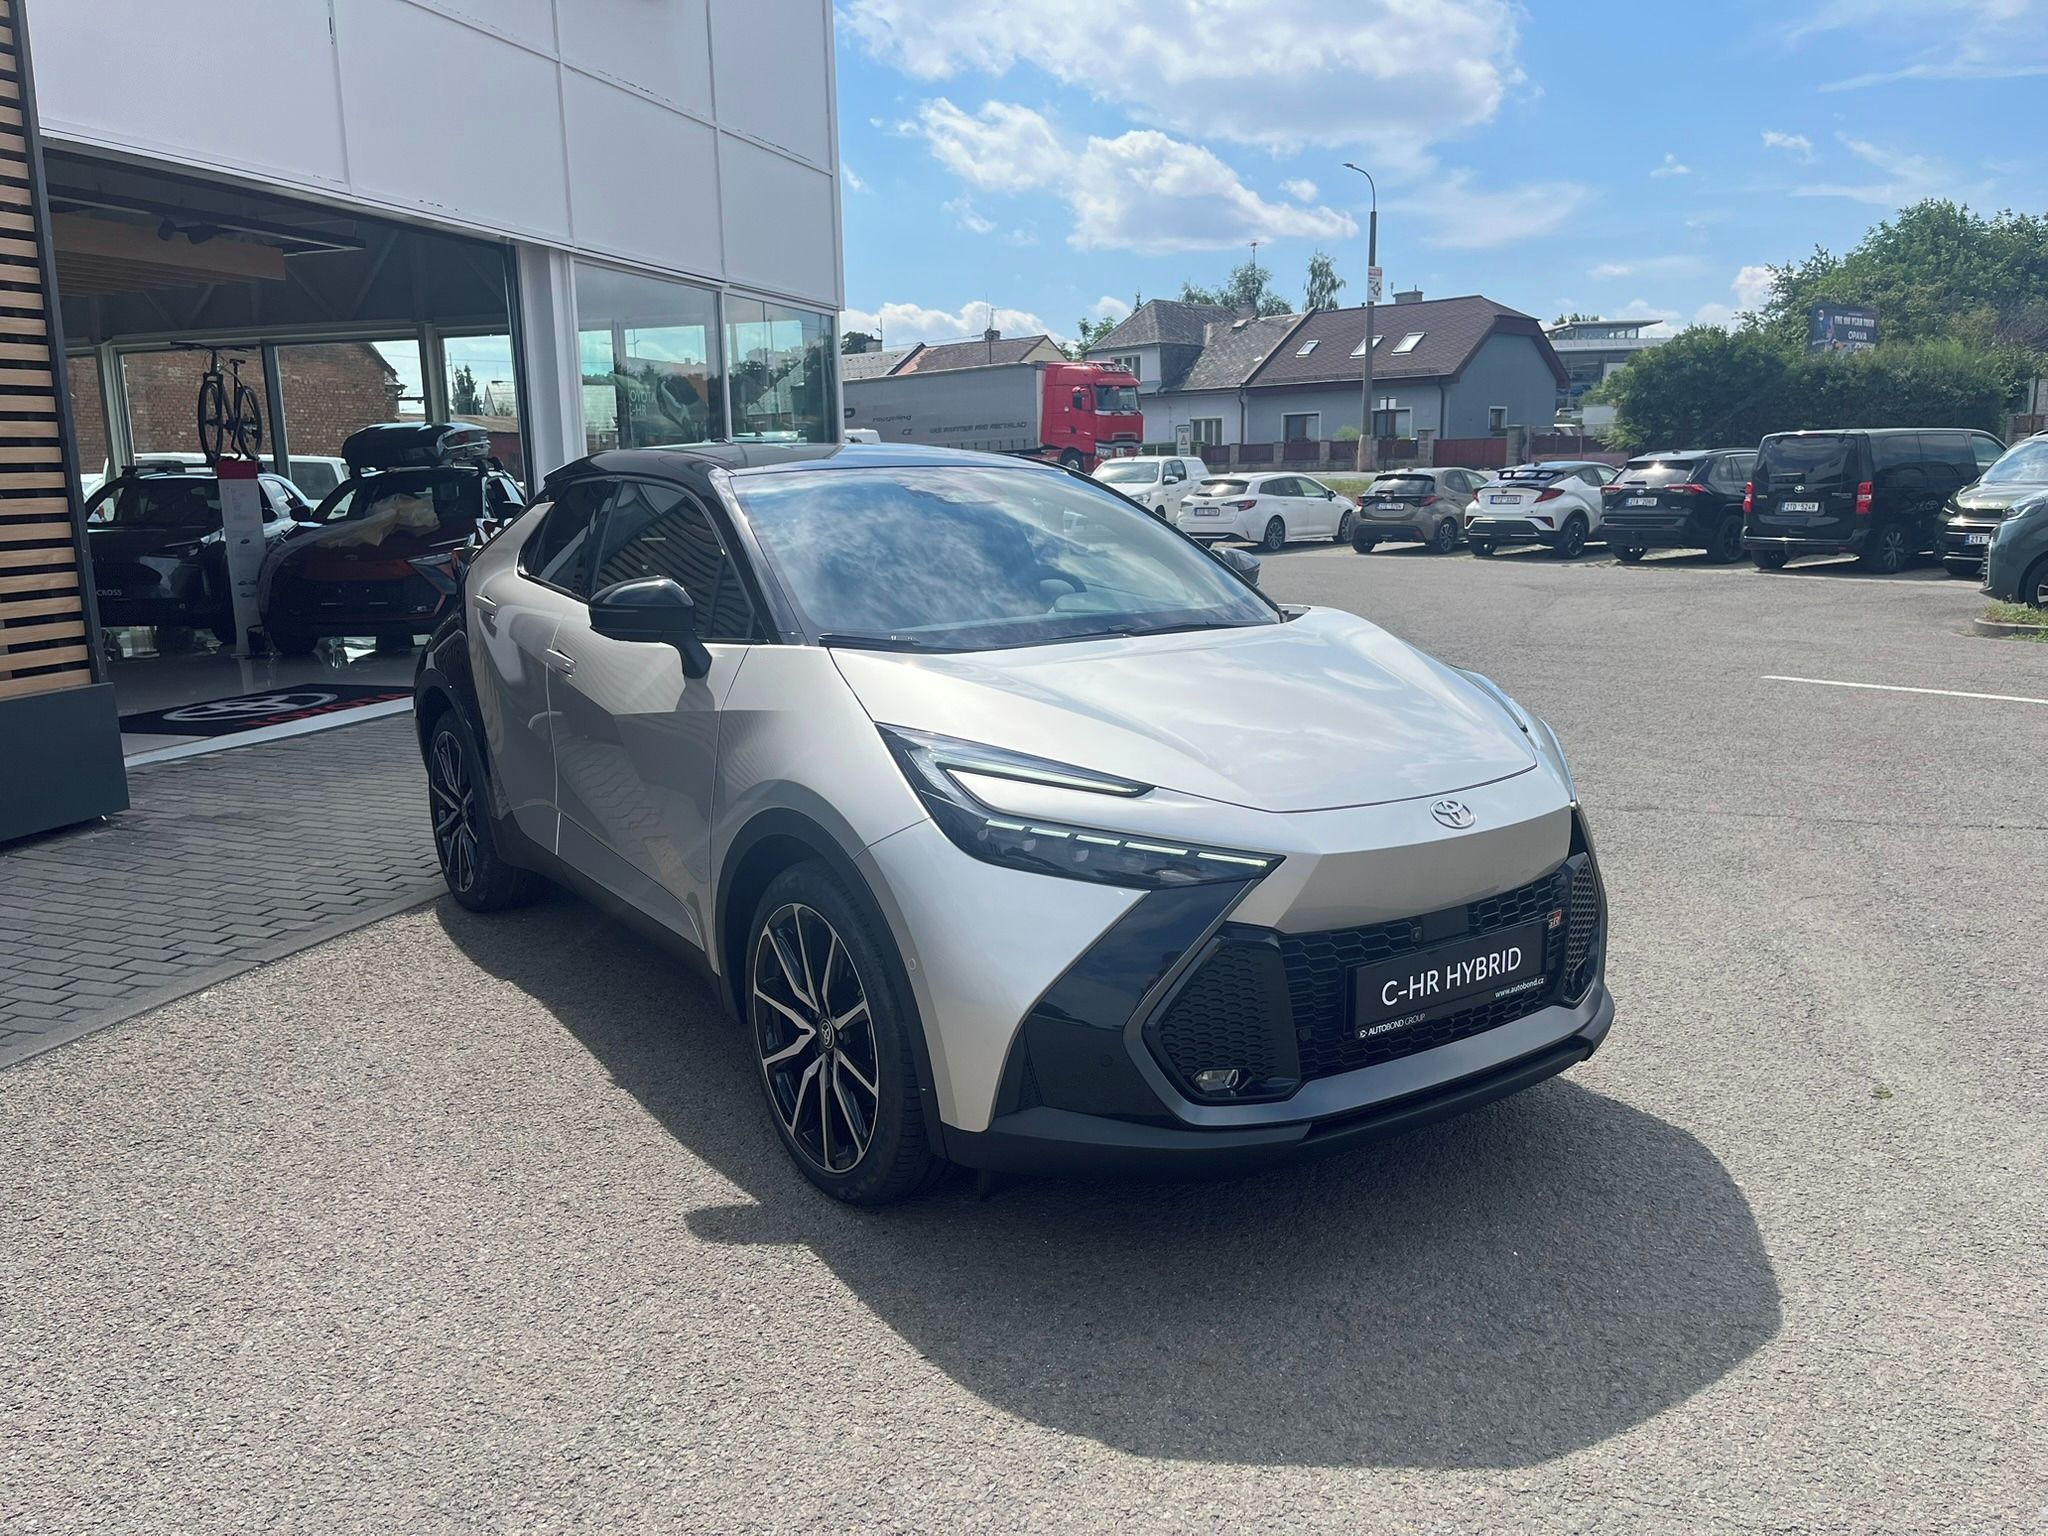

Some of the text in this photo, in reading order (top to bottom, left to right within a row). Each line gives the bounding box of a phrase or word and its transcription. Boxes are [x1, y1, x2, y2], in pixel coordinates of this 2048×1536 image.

[1847, 330, 1868, 341] OPAVA
[630, 390, 657, 404] OYOTA
[96, 589, 122, 597] CROSS
[1381, 947, 1522, 1006] C-HR HYBRID
[1495, 977, 1545, 998] www.autobond.cz
[1368, 1013, 1426, 1036] AUTOBOND GROUP
